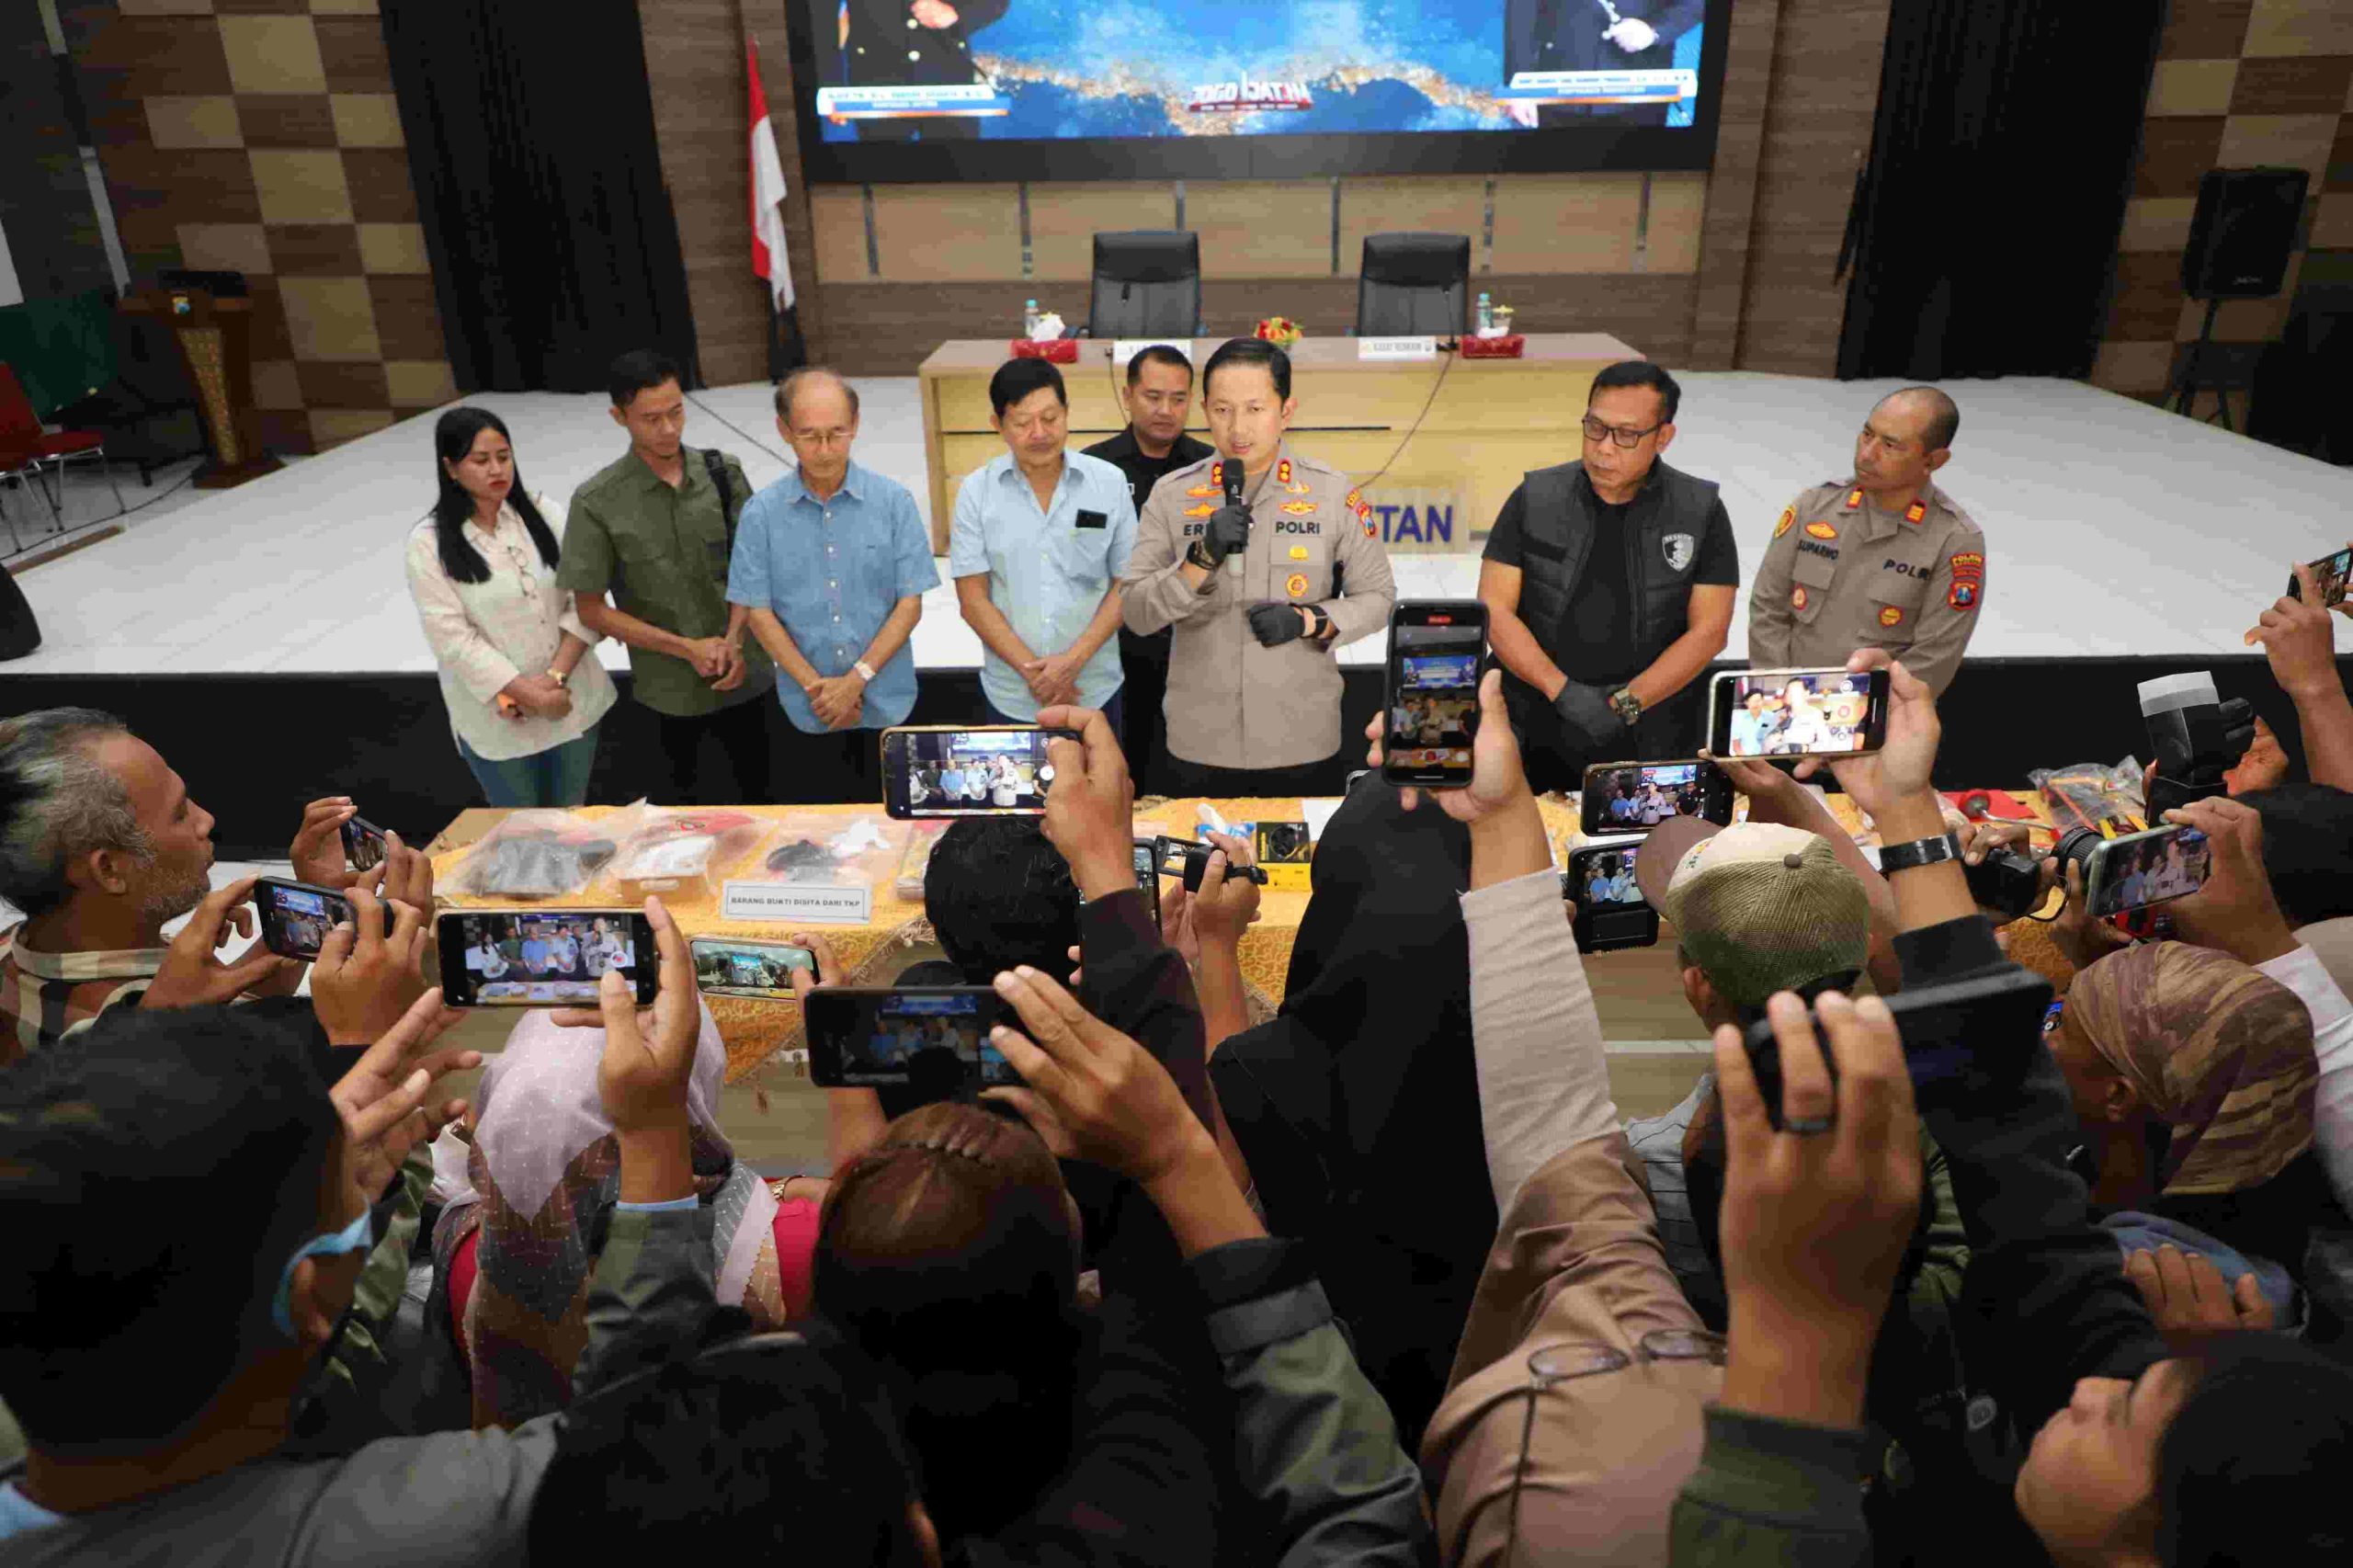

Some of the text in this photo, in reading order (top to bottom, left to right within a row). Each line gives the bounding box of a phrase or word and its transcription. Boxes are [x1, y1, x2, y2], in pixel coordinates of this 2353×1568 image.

[1184, 524, 1204, 536] ER
[1276, 521, 1320, 534] POLRI
[1369, 506, 1453, 543] TAN
[730, 896, 765, 905] BARANG
[767, 897, 792, 906] BUKTI
[793, 899, 821, 907] DISITA
[823, 900, 843, 908] DARI
